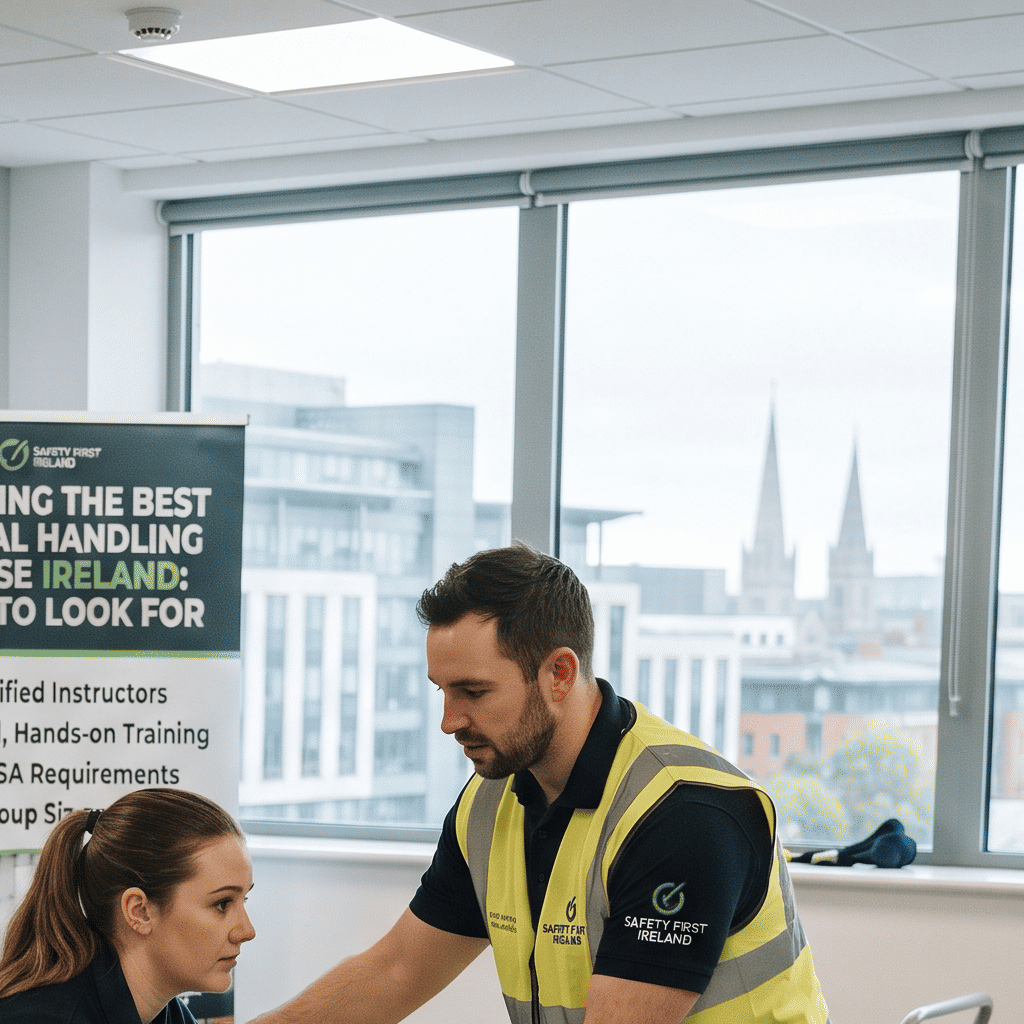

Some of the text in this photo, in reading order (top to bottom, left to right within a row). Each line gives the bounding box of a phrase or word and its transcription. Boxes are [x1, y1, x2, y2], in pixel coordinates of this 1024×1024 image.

[61, 485, 124, 517] THE
[133, 486, 213, 518] BEST
[37, 523, 204, 555] HANDLING
[43, 560, 188, 591] IRELAND:
[45, 596, 134, 628] LOOK
[140, 597, 205, 628] FOR
[52, 681, 168, 704] Instructors
[14, 721, 116, 744] Hands-on
[122, 722, 210, 750] Training
[31, 761, 180, 790] Requirements
[624, 915, 708, 934] SAFETY FIRST
[637, 929, 692, 946] IRELAND
